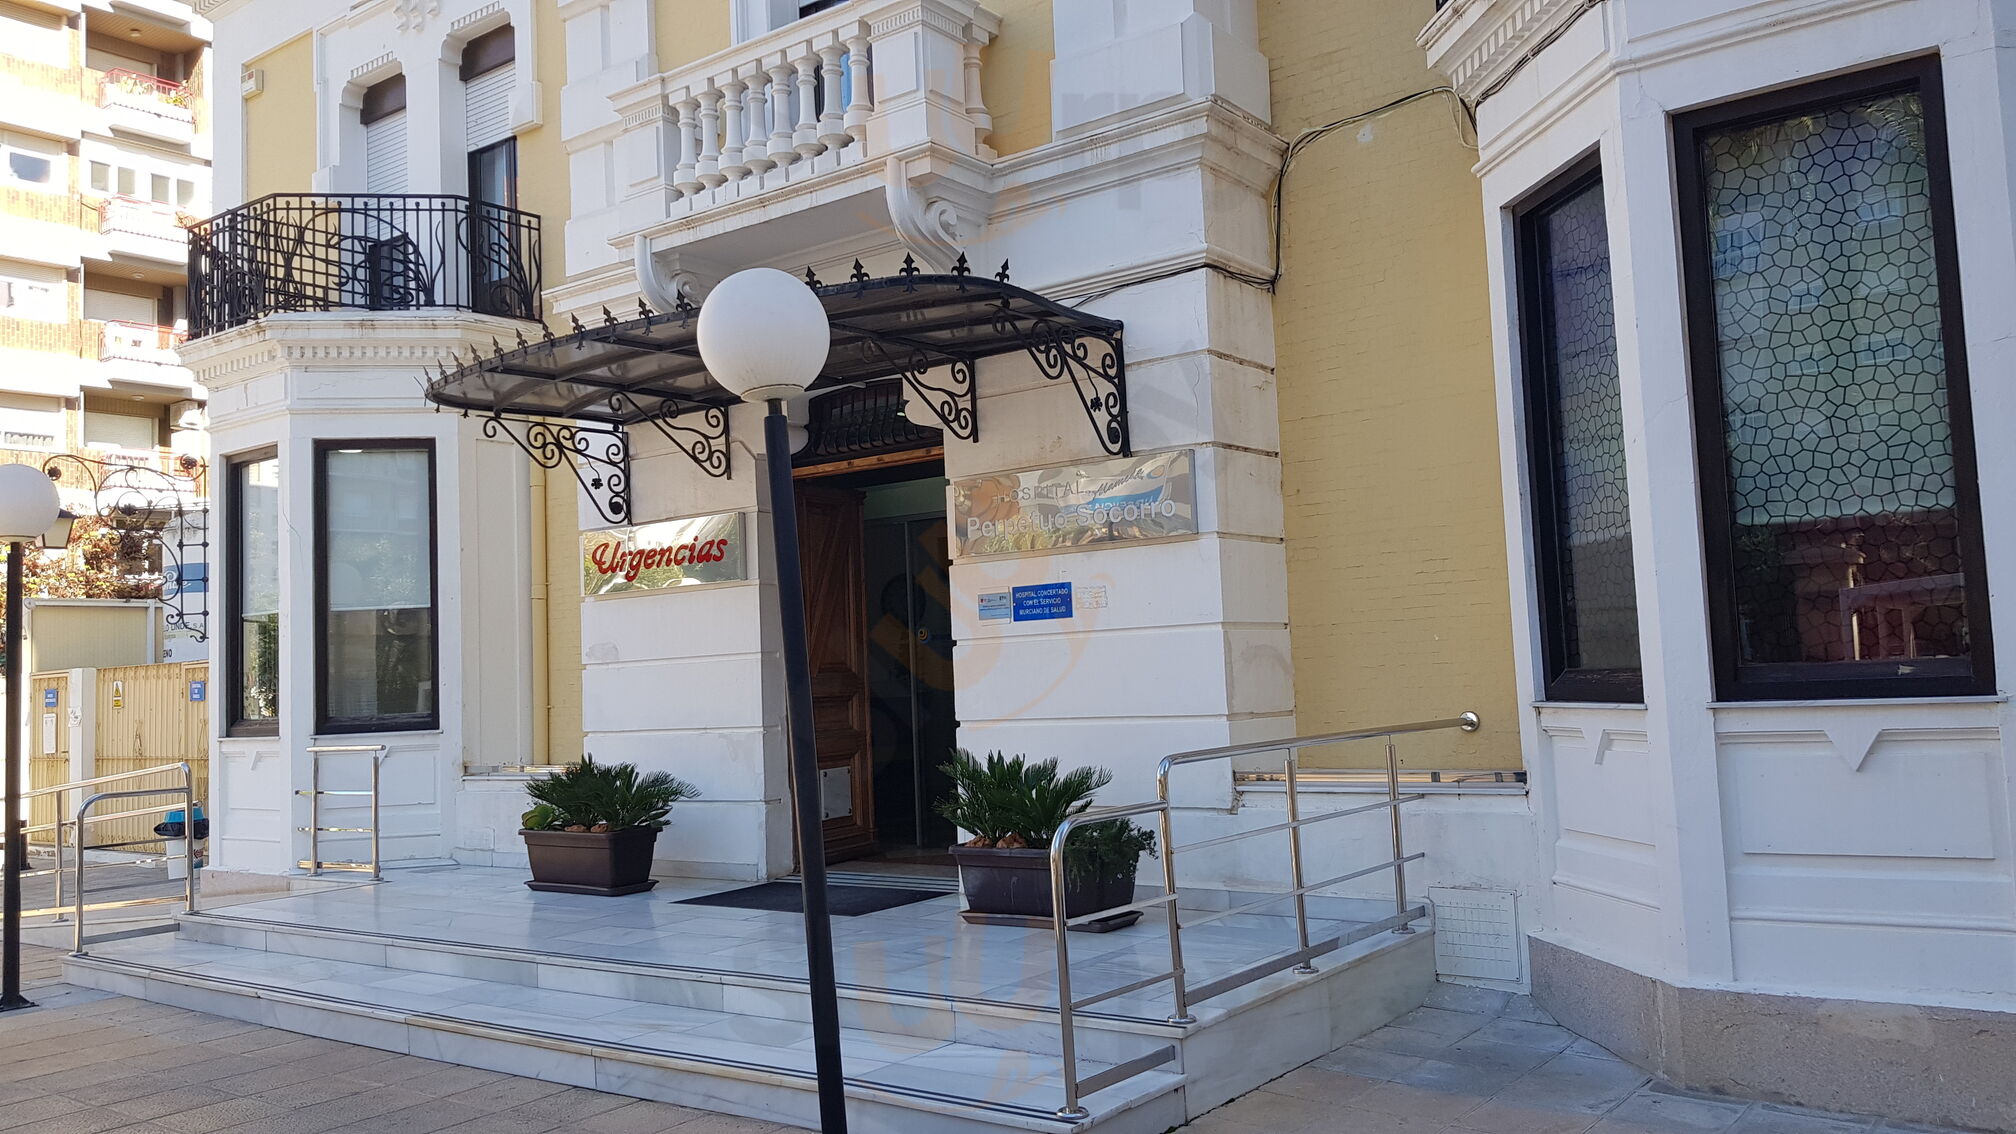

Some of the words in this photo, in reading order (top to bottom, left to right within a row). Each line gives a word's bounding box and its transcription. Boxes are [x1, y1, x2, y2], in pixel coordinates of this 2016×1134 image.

[997, 480, 1084, 503] HOSPITAL
[967, 511, 1066, 540] Perpetuo
[1076, 499, 1176, 527] Socorro
[591, 536, 728, 582] Urgencias
[1016, 591, 1037, 599] HOSPITAL
[1037, 588, 1069, 597] CONCERTADO
[1040, 597, 1062, 605] SERVICIO
[1019, 607, 1043, 615] MURCIANO
